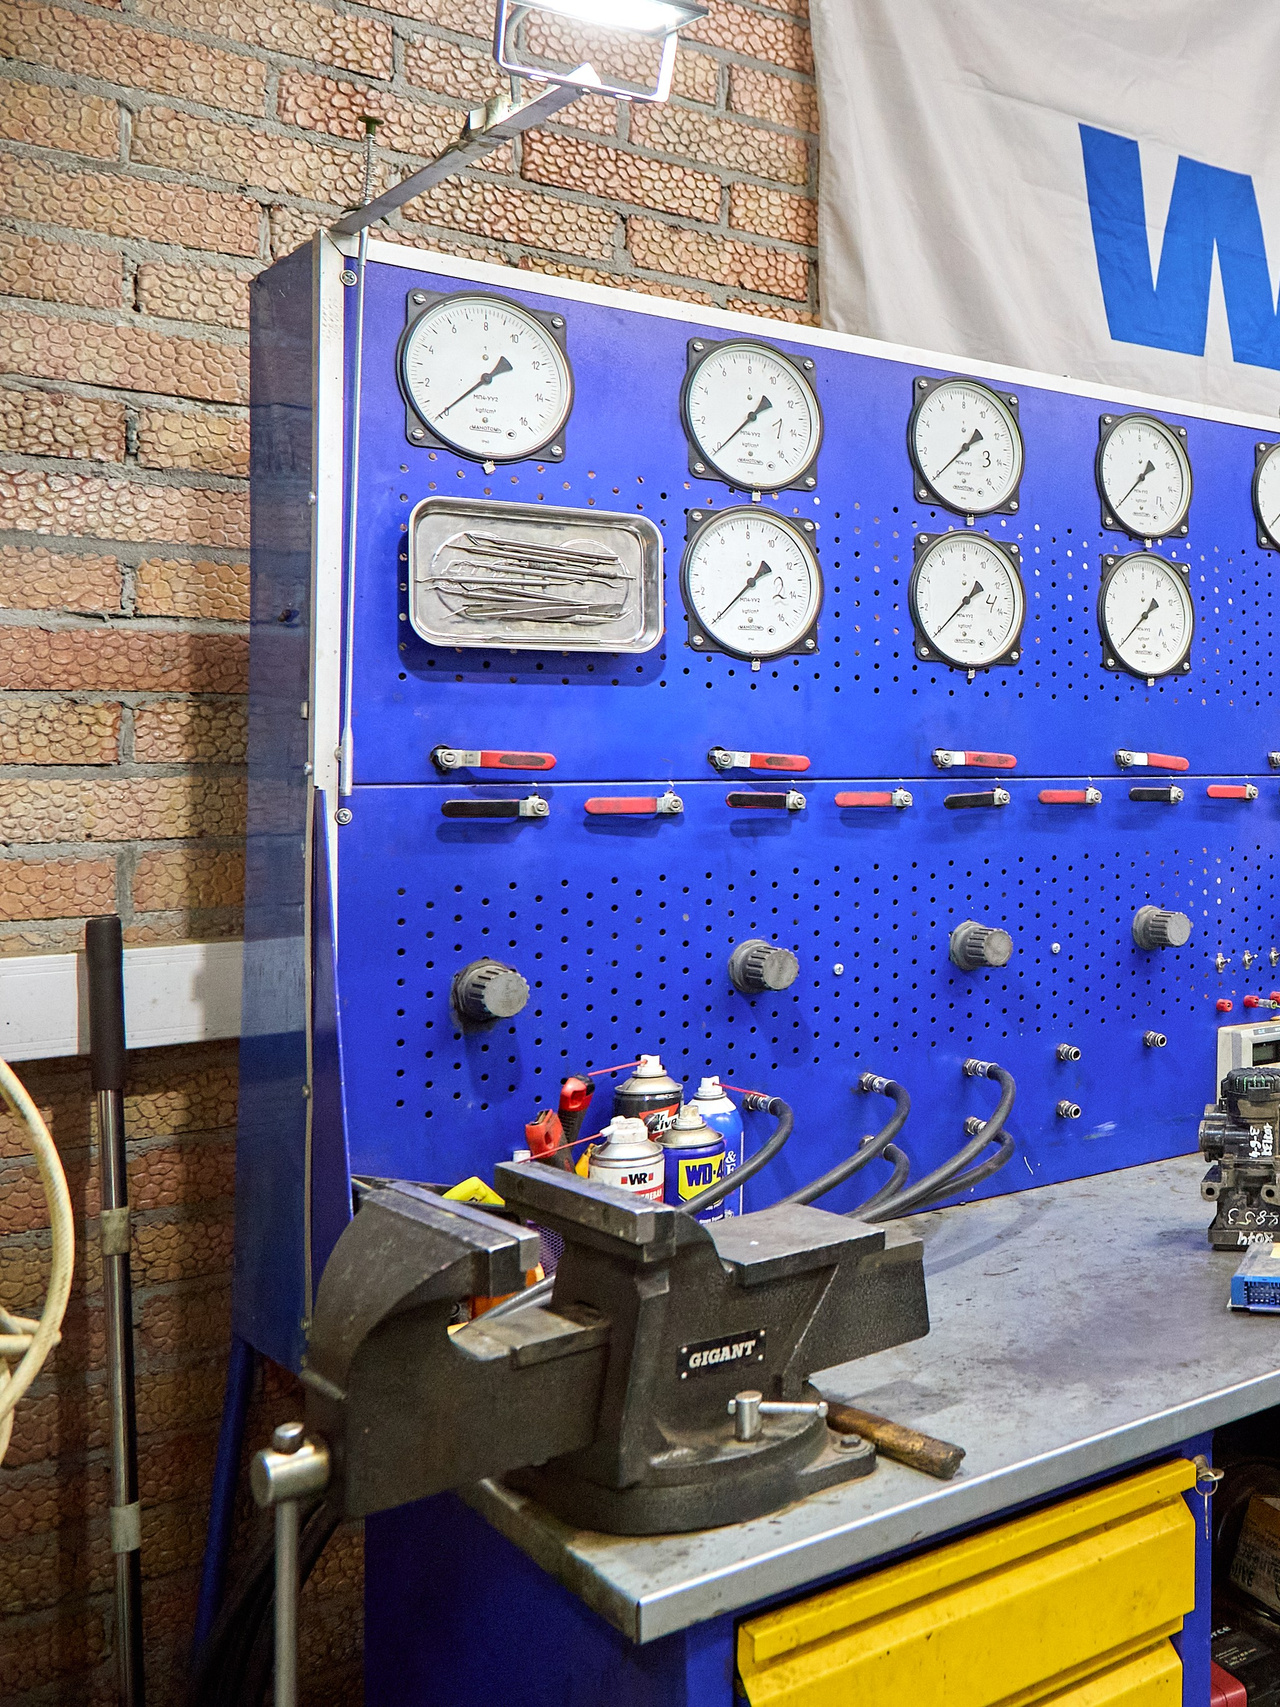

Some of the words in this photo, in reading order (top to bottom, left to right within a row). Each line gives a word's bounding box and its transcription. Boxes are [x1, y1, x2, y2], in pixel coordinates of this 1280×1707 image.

[451, 325, 457, 334] 6
[483, 322, 489, 331] 8
[510, 334, 519, 343] 10
[429, 345, 434, 354] 4
[532, 361, 541, 370] 12
[425, 378, 430, 387] 2
[769, 377, 777, 385] 10
[535, 394, 544, 402] 14
[787, 400, 794, 408] 12
[520, 417, 529, 426] 16
[772, 418, 783, 439] 1
[982, 450, 992, 468] 3
[772, 576, 788, 600] 2
[986, 594, 997, 613] 4
[689, 1340, 756, 1368] GIGANT
